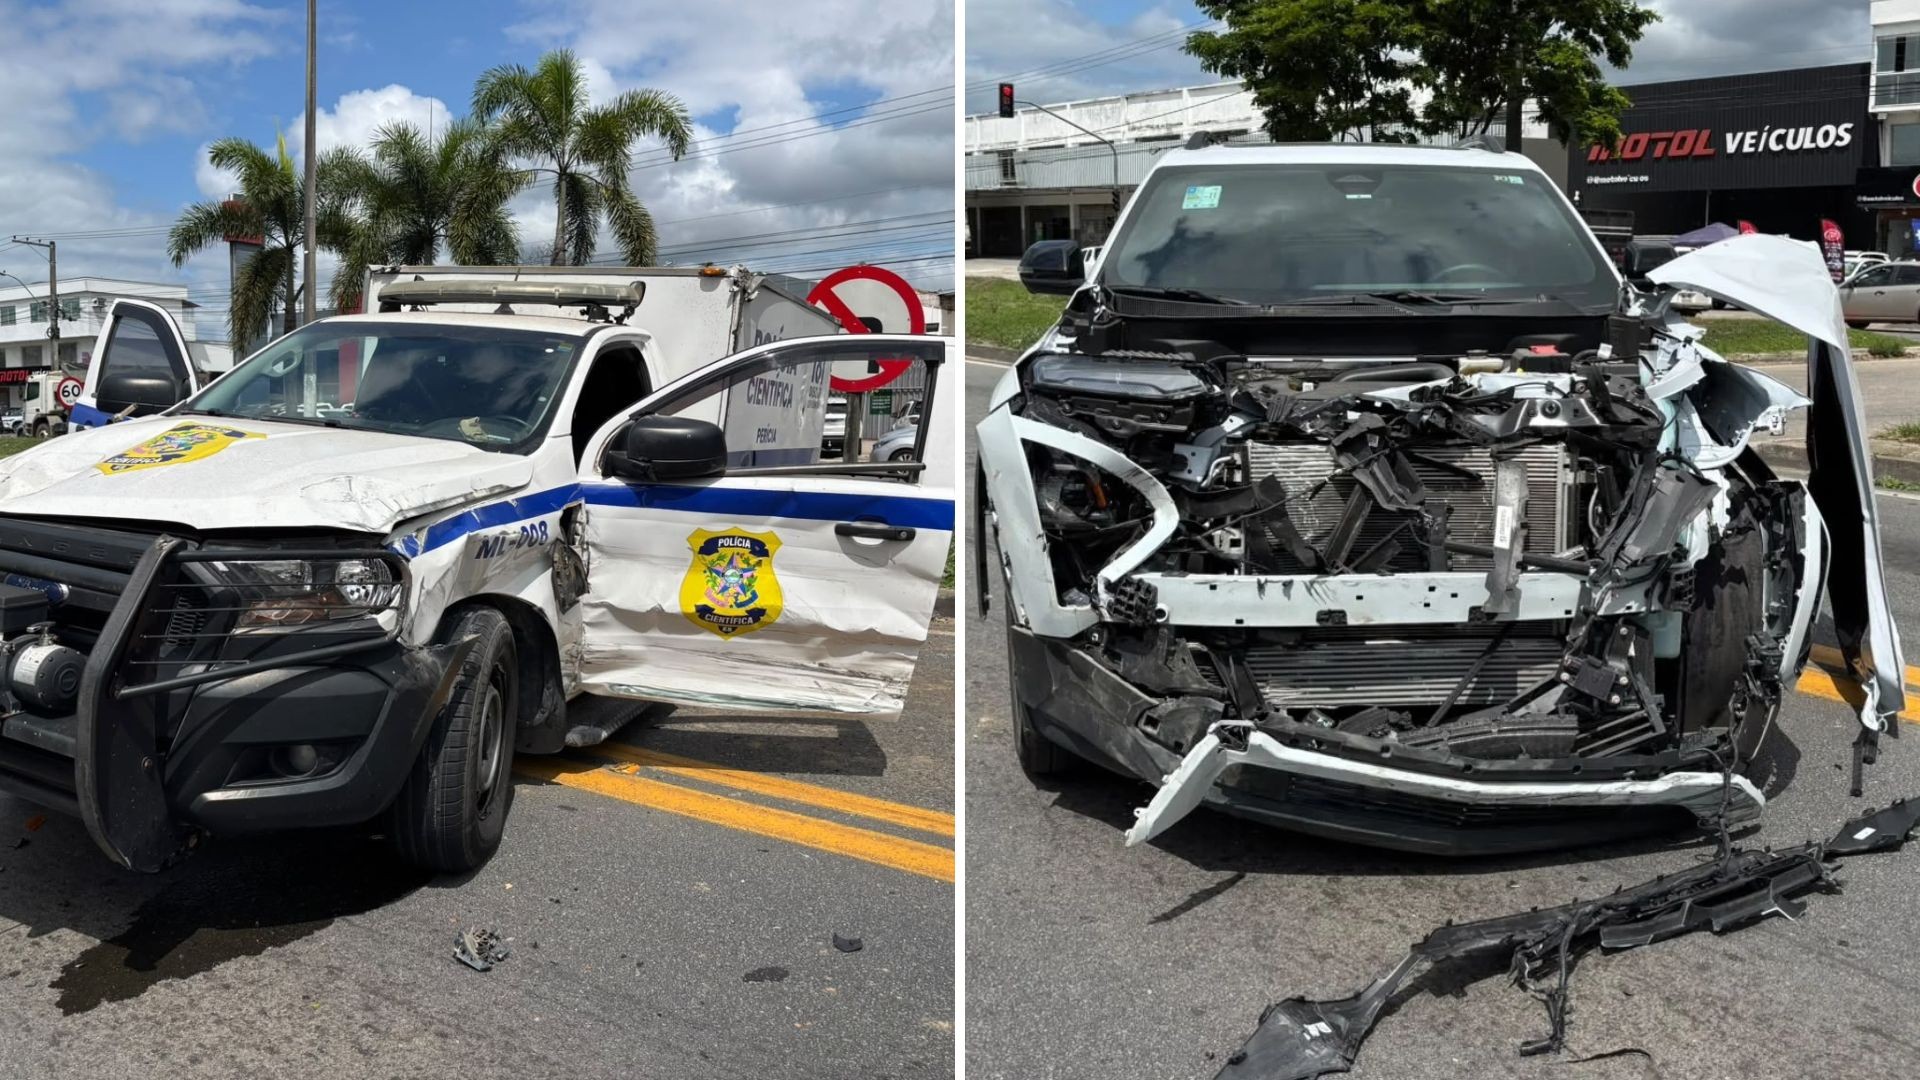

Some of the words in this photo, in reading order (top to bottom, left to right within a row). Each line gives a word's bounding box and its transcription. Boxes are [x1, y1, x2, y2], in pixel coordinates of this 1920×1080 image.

[1725, 123, 1854, 154] VEÍCULOS
[62, 384, 80, 398] 60
[747, 373, 793, 408] CIENTÍFICA
[756, 424, 776, 443] PERÍCIA
[718, 537, 751, 548] POLÍCIA
[705, 613, 754, 625] CIENTÍFICA
